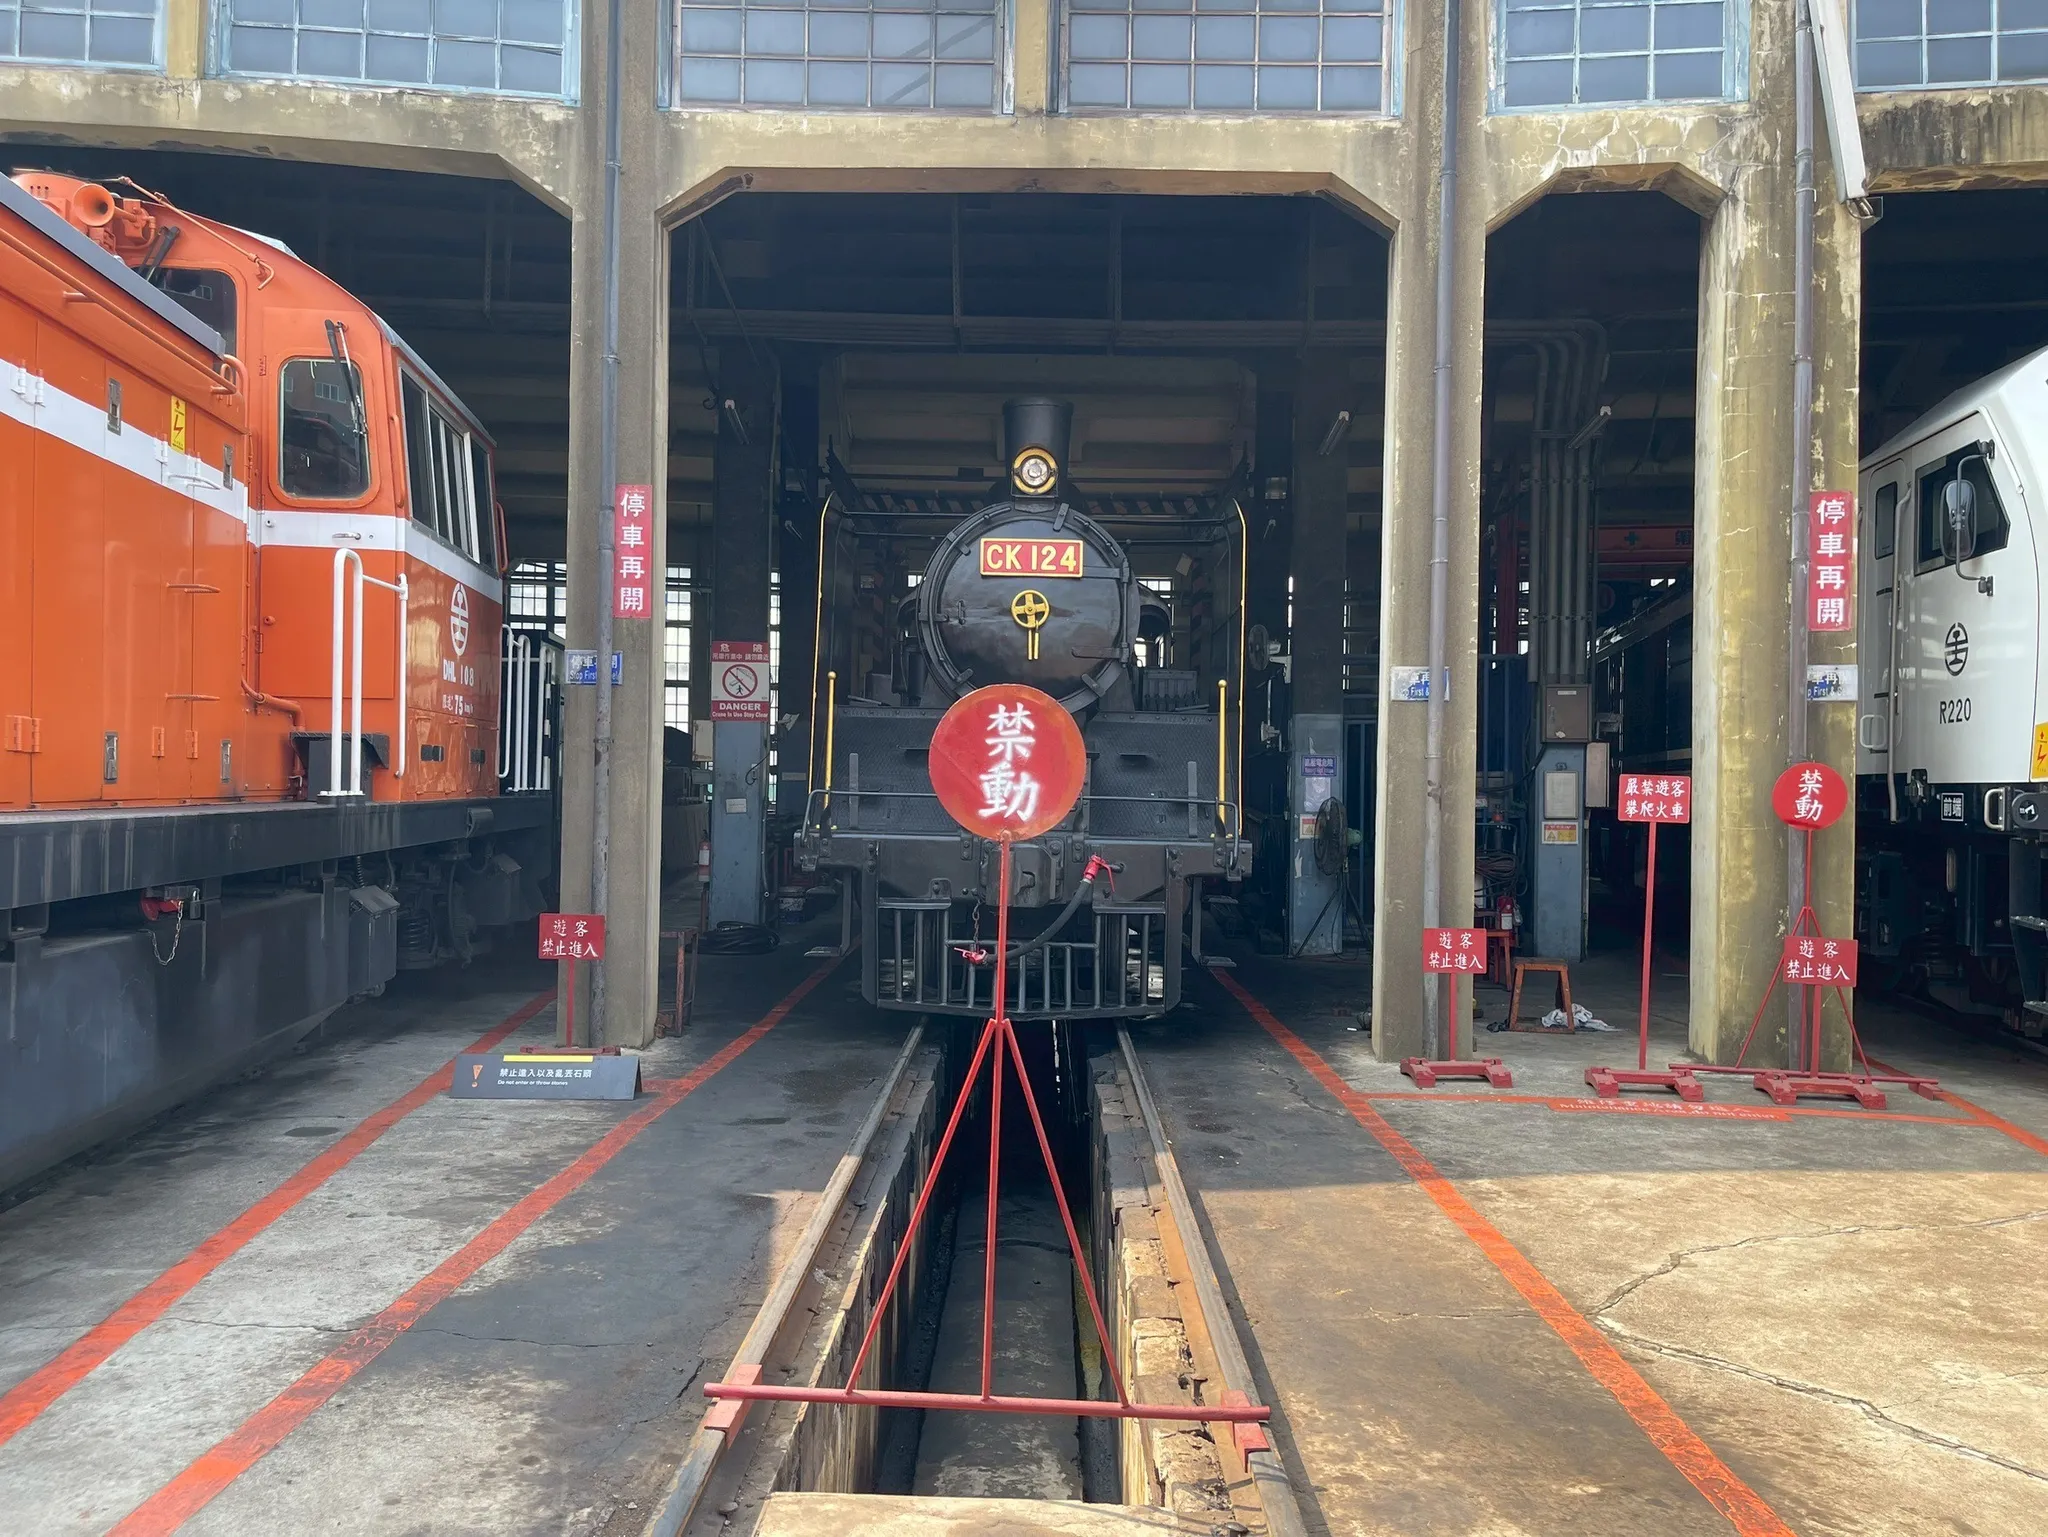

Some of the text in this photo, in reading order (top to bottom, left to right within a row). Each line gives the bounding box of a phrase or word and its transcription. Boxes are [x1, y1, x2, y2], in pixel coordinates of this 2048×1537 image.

[620, 492, 645, 612] 停車再開
[986, 544, 1077, 572] CK 124
[1816, 498, 1846, 625] 停車再開
[720, 642, 763, 653] 危險
[443, 658, 475, 687] DHL 108
[569, 669, 597, 680] Stop Firs
[1410, 686, 1425, 697] First
[1813, 686, 1829, 697] First
[455, 694, 464, 716] 75
[719, 702, 762, 711] DANGER
[744, 711, 754, 719] Stay
[1939, 697, 1972, 724] R220
[978, 701, 1040, 823] 禁動
[1624, 777, 1686, 798] 嚴禁遊客
[1794, 768, 1824, 822] 禁動
[1624, 799, 1684, 819] 攀爬火車
[553, 919, 589, 937] 遊客
[542, 938, 599, 958] 禁止進入
[1439, 931, 1474, 950] 遊客
[1799, 939, 1839, 959] 遊客
[1428, 950, 1484, 970] 禁止進入
[1786, 959, 1851, 981] 禁止進入
[499, 1068, 593, 1078] 禁止進入以及亂丟石頭
